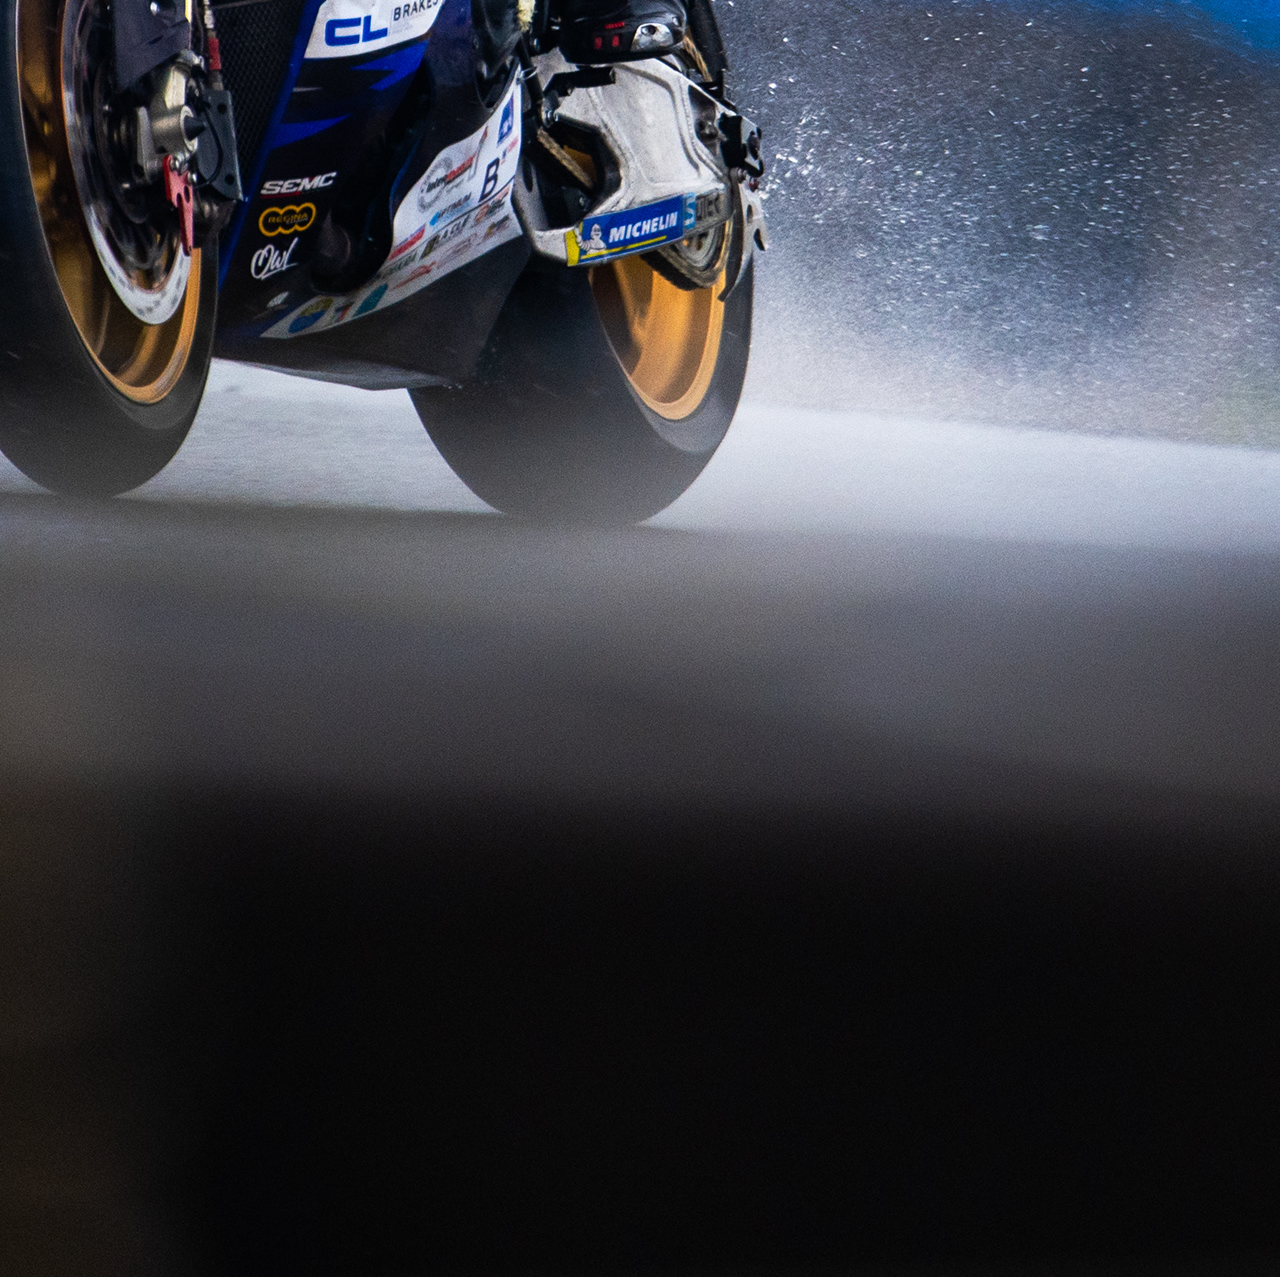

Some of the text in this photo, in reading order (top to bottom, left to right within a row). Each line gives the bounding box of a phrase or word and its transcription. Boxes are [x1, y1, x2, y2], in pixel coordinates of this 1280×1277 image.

[325, 14, 388, 47] CL
[260, 172, 337, 195] SEMC
[608, 211, 678, 243] MICHELIN
